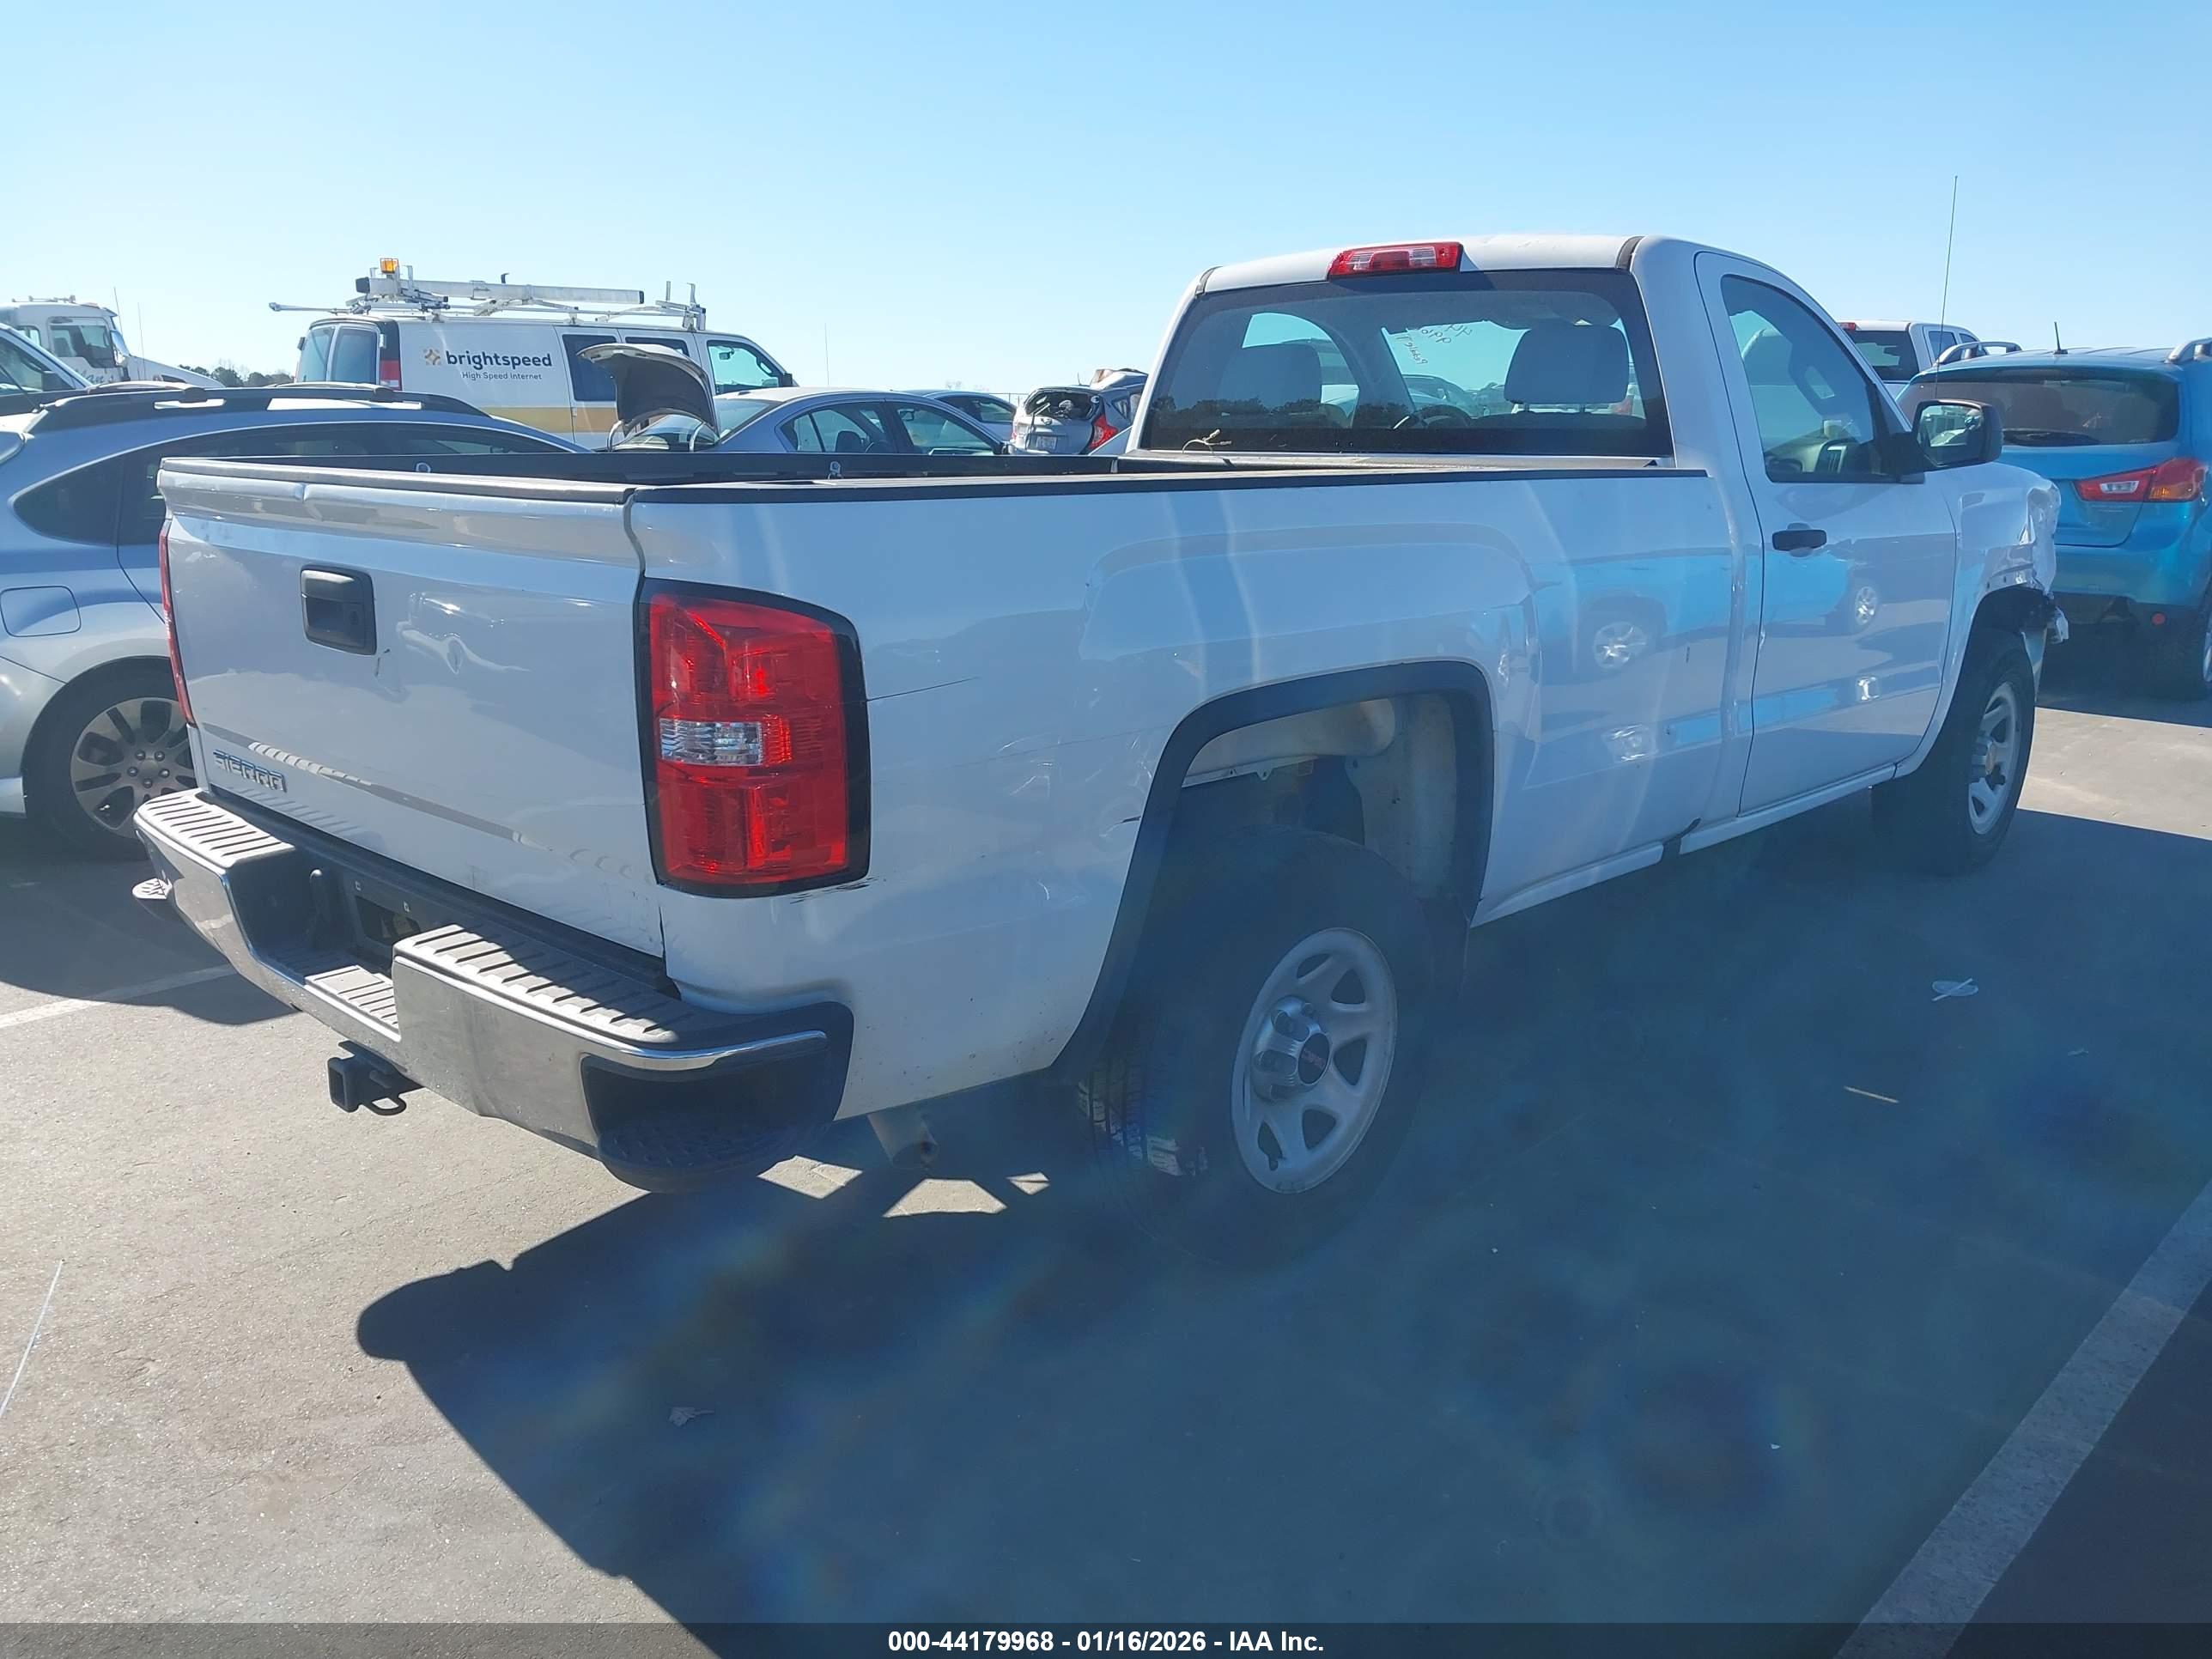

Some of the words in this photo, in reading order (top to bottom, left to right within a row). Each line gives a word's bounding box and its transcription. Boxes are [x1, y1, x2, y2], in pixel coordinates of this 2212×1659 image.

[446, 350, 552, 370] brightspeed
[462, 372, 481, 380] High
[483, 372, 507, 380] Speed
[213, 750, 287, 793] SIERRA
